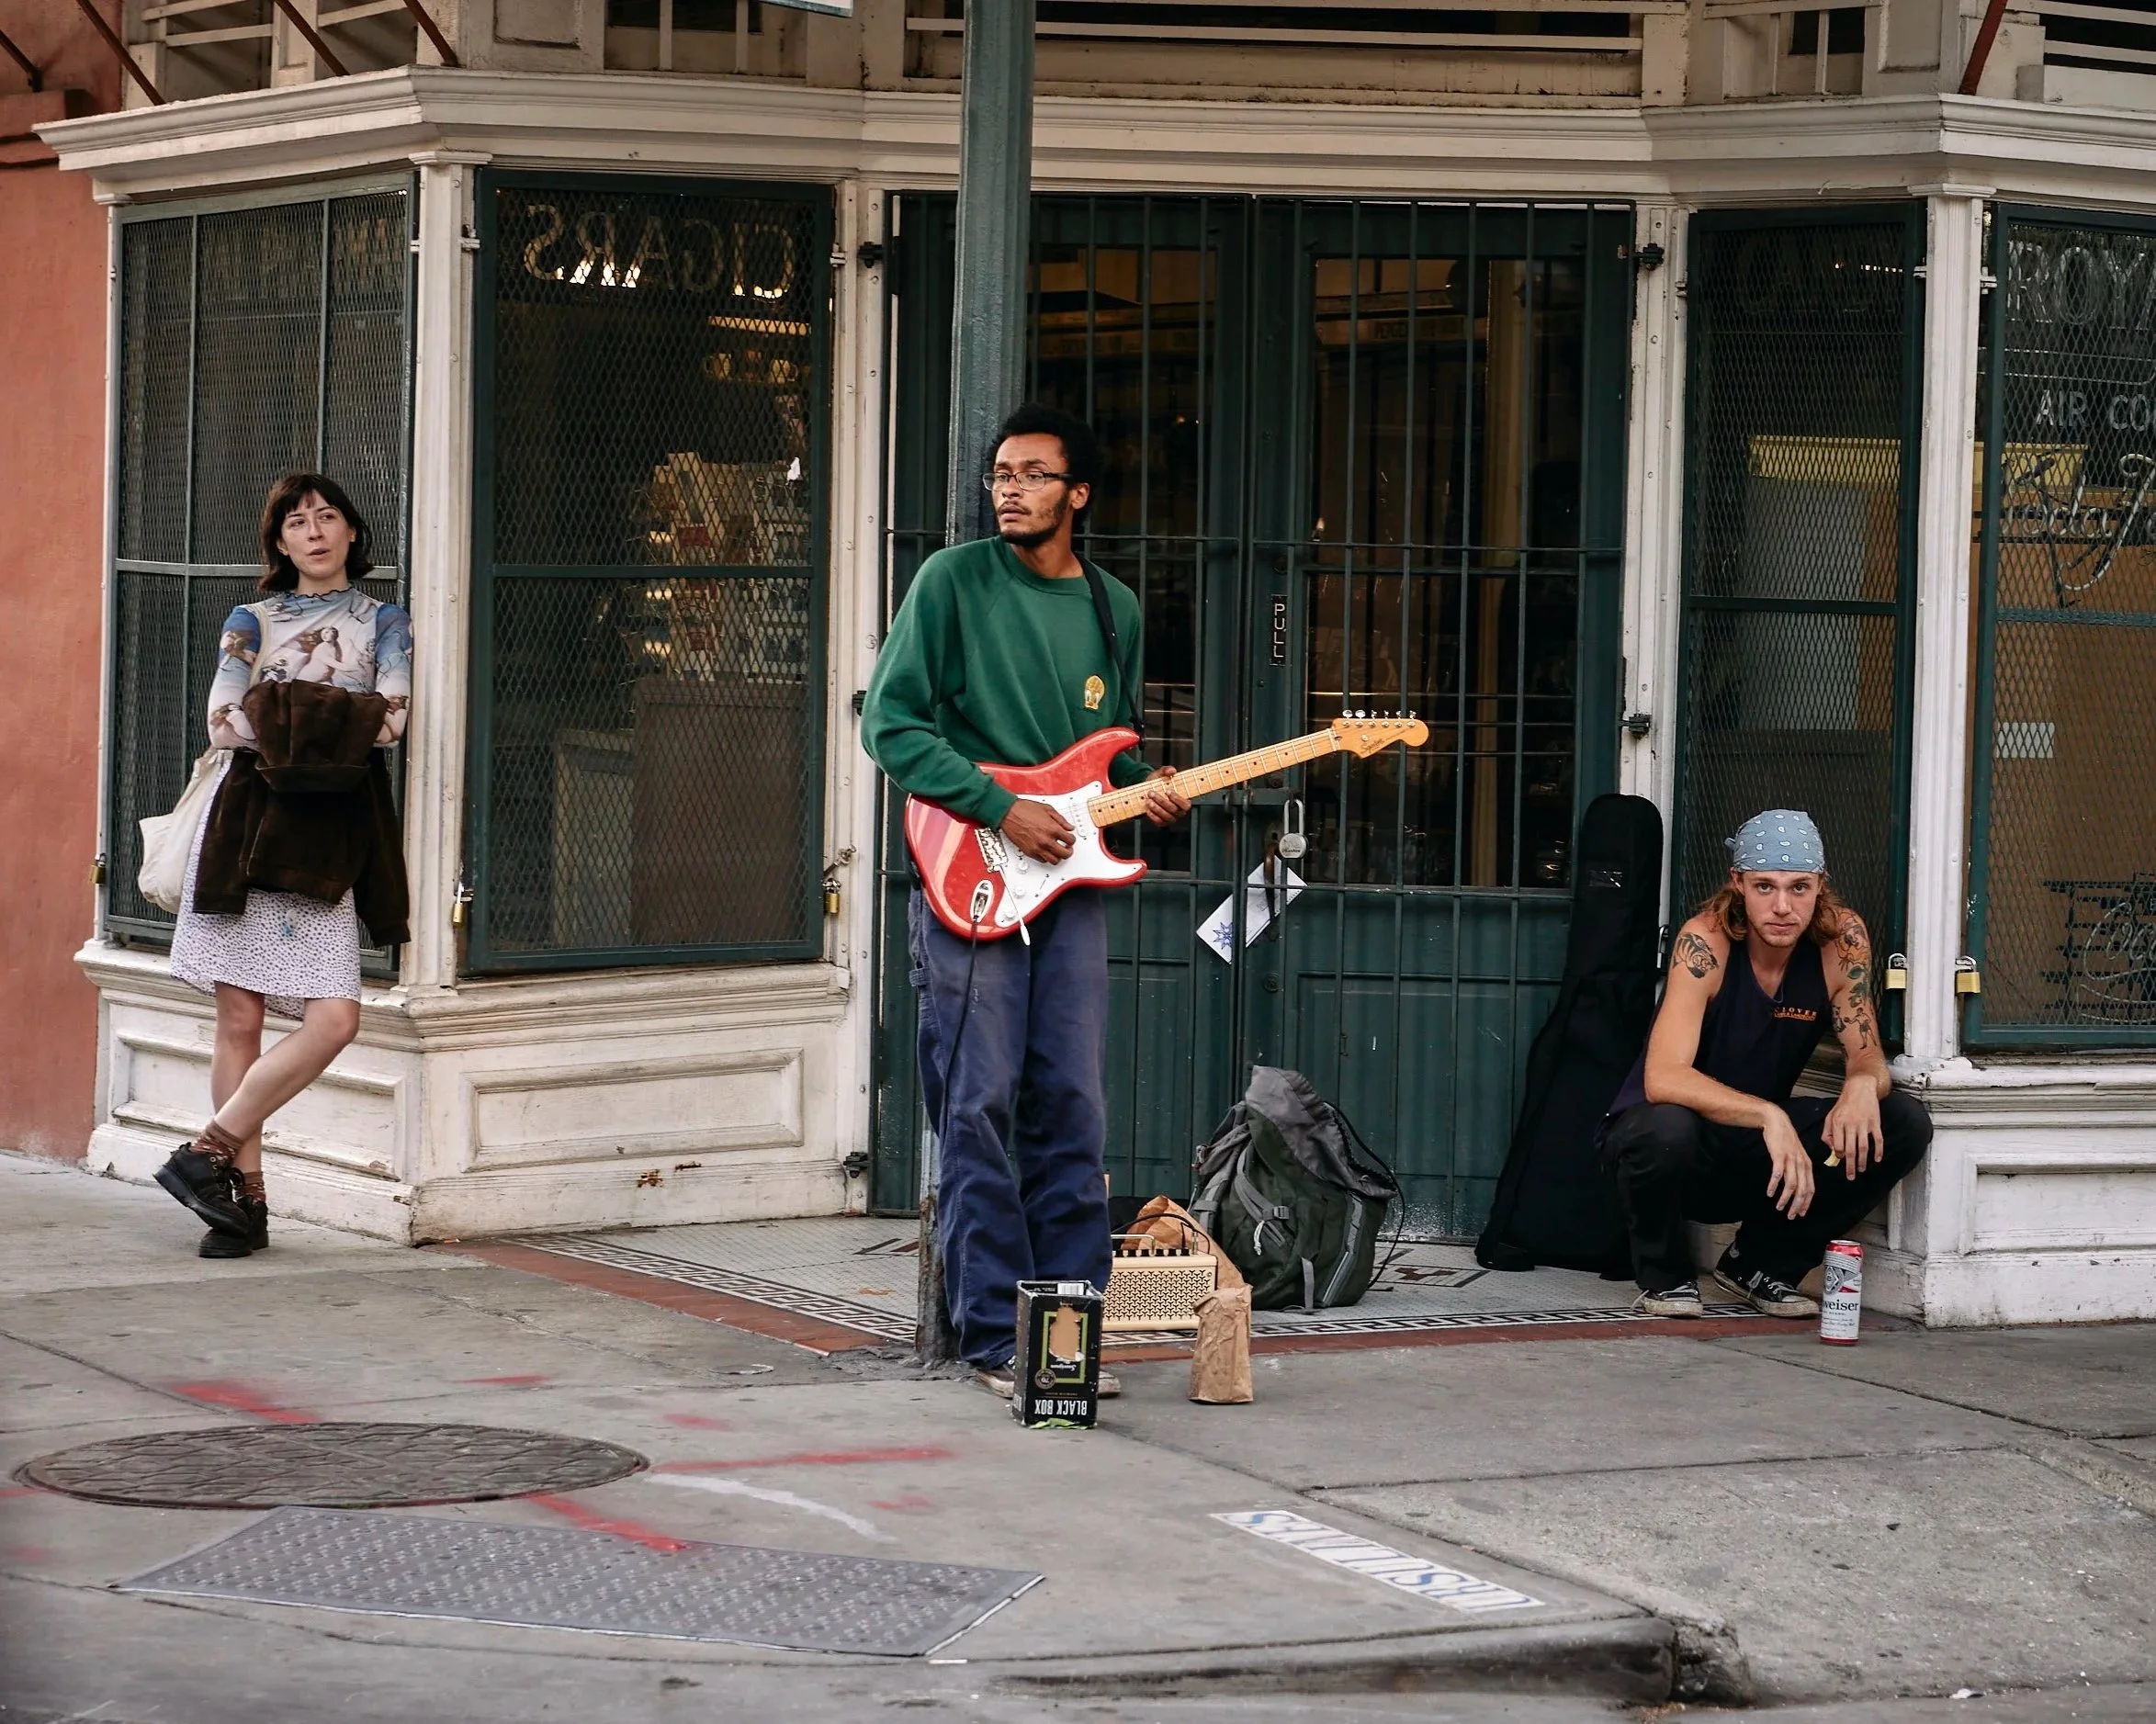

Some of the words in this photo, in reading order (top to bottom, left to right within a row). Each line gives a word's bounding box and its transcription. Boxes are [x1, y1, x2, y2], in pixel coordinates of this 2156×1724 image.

[2036, 389, 2088, 426] AIR
[2109, 393, 2156, 433] CO
[1273, 603, 1286, 659] PULL
[1034, 1399, 1054, 1414] BOX
[1056, 1400, 1088, 1415] BLACK
